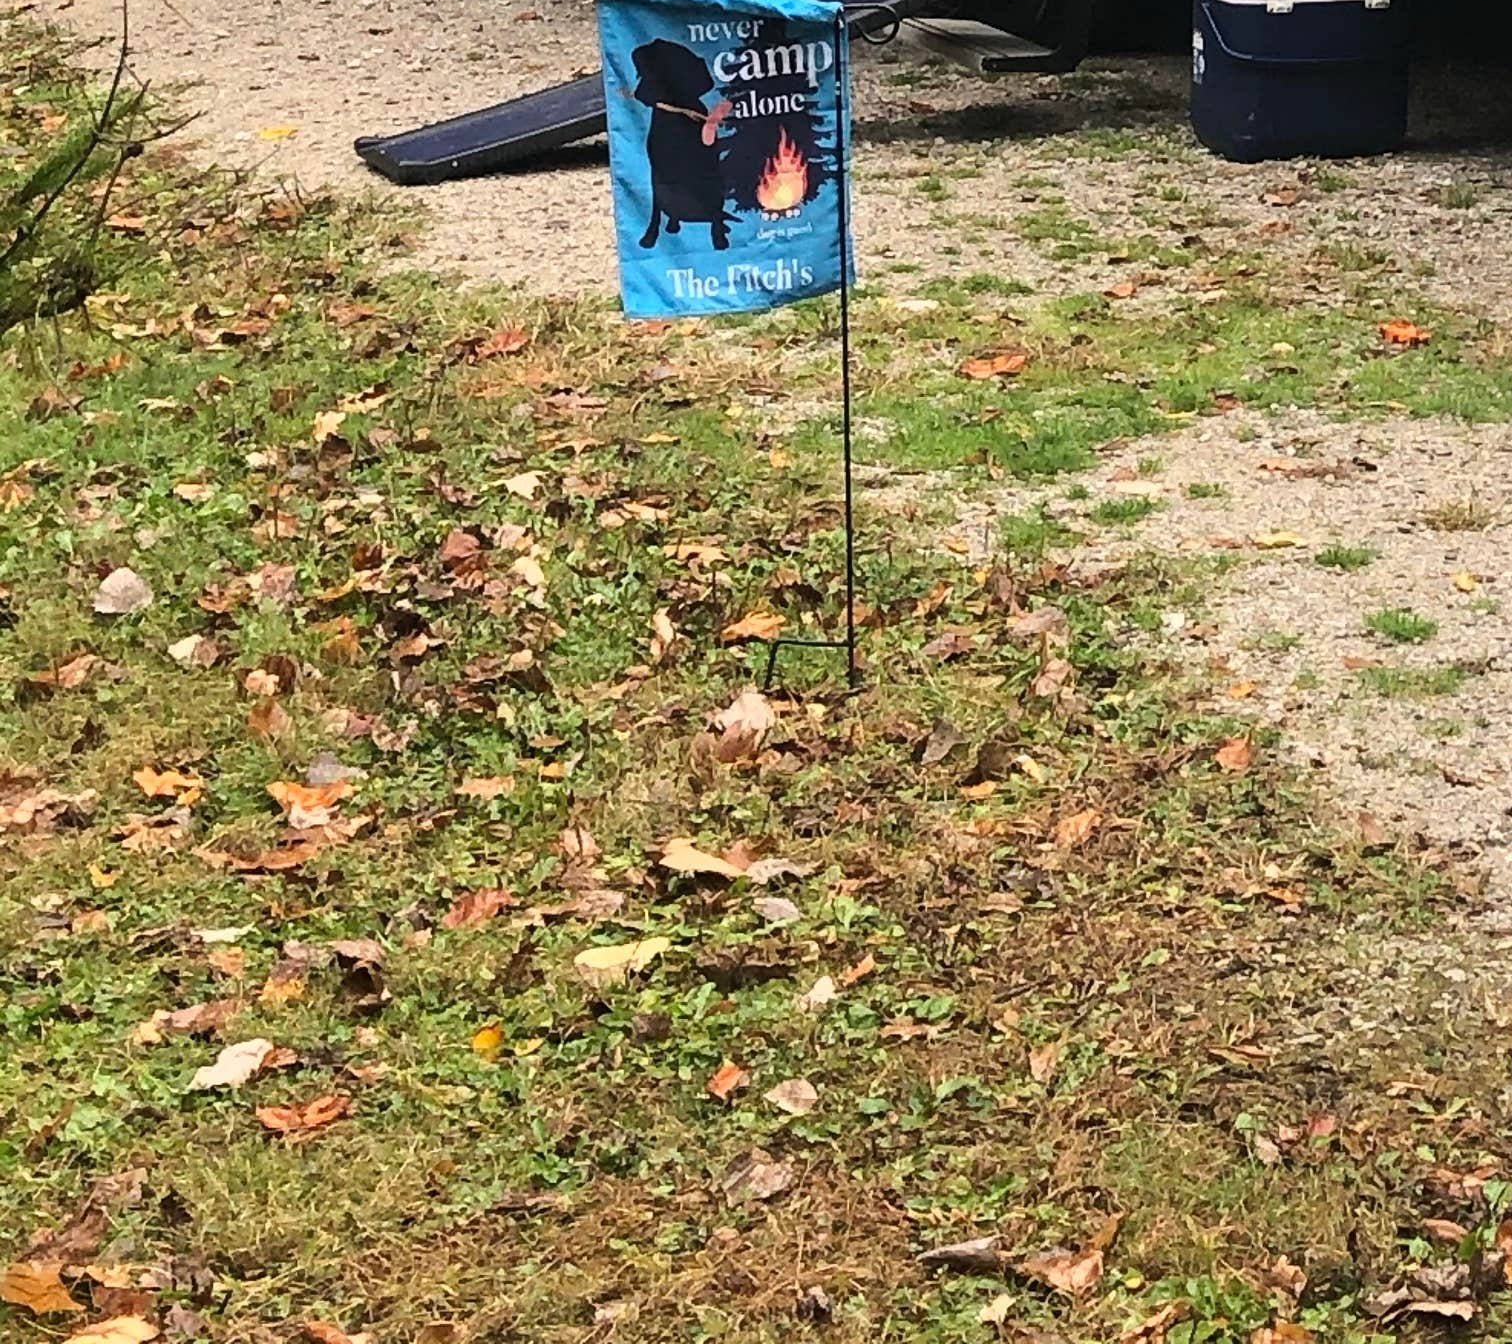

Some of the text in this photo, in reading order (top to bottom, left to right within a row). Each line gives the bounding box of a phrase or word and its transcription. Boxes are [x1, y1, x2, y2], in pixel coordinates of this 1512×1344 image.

[687, 19, 764, 42] never
[713, 40, 833, 88] camp
[735, 90, 806, 119] alone
[666, 258, 814, 299] The Fitch's
